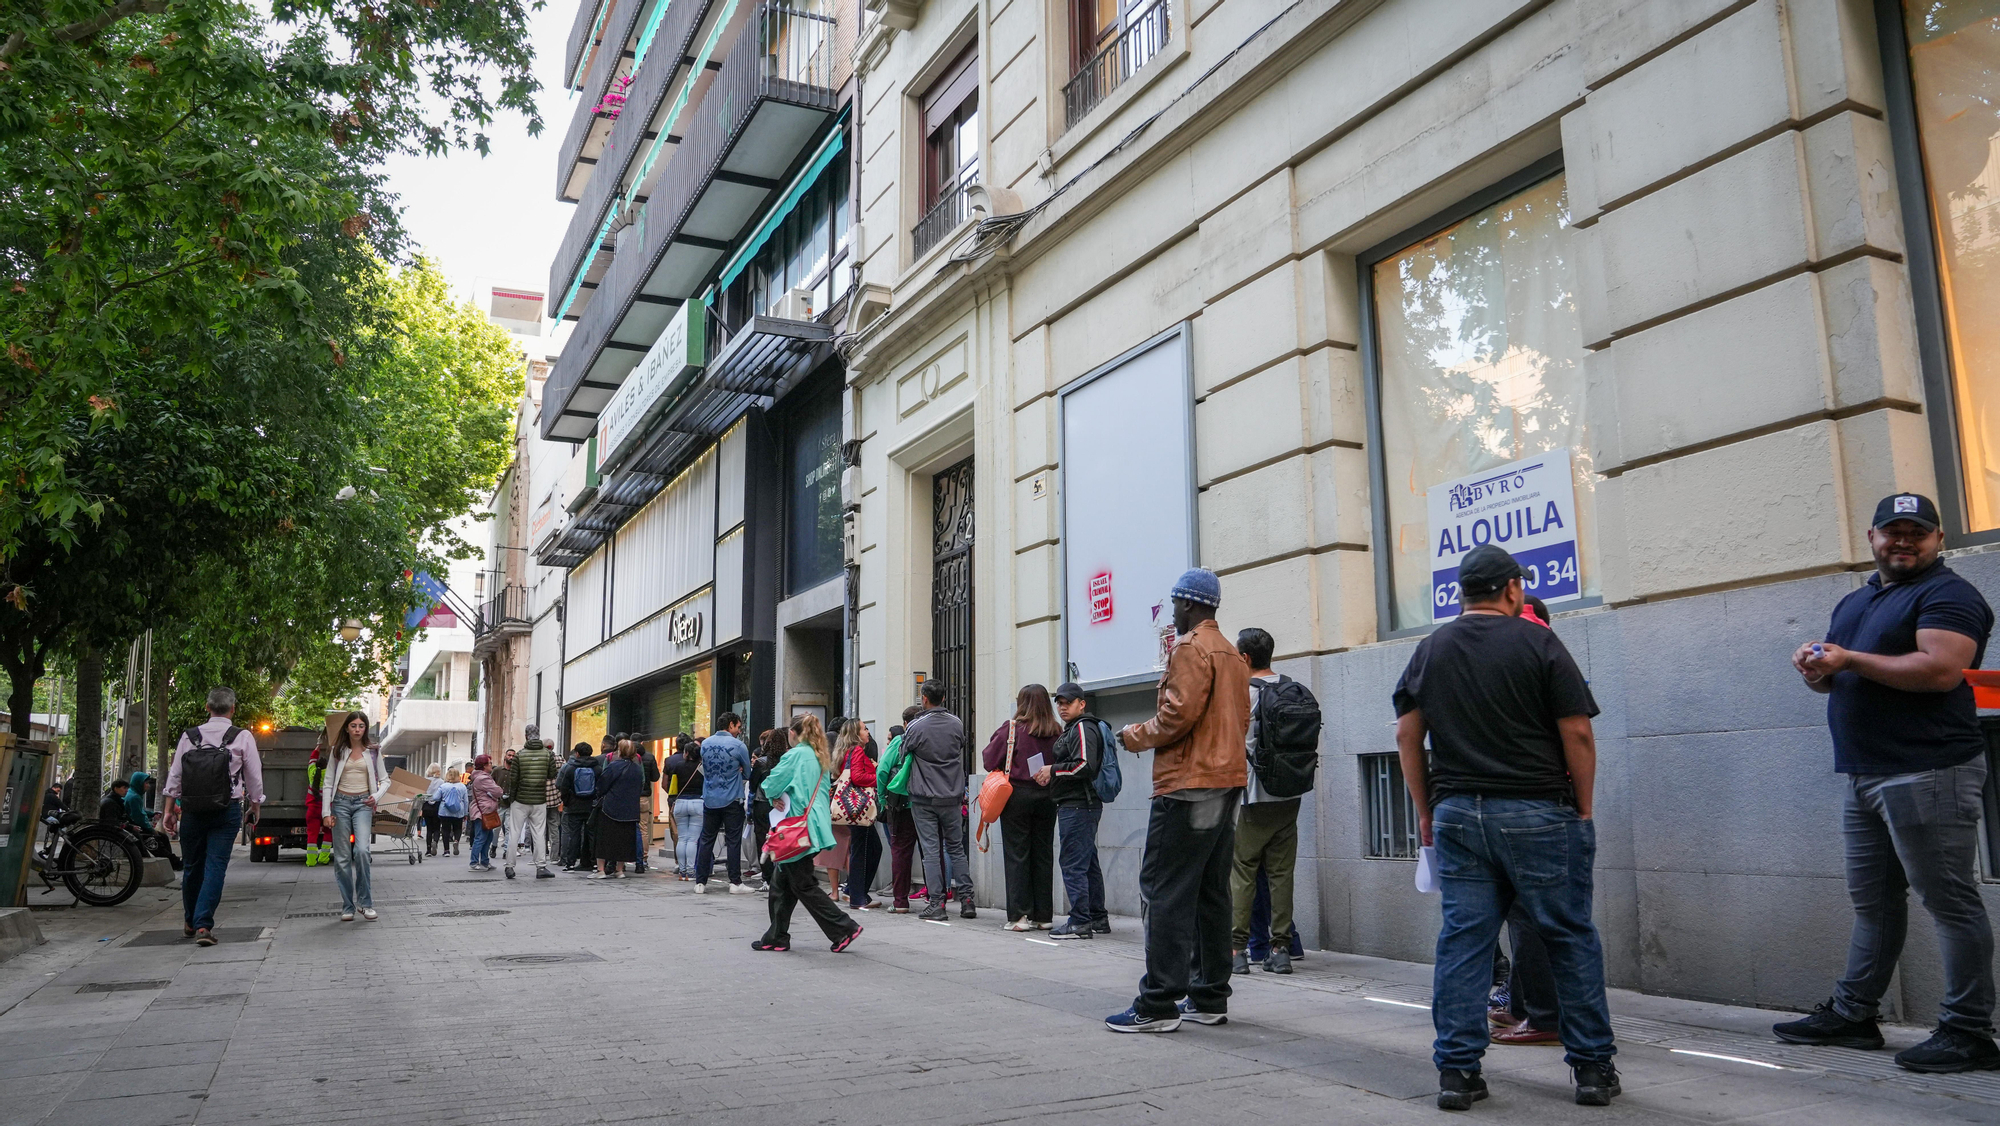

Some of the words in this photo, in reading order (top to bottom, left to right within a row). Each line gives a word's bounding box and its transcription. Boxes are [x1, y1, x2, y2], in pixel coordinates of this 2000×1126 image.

[608, 386, 635, 434] AVILÉS
[637, 375, 645, 396] &
[646, 322, 683, 385] IBÁÑEZ
[1455, 509, 1474, 519] AGENCIA
[1486, 499, 1511, 511] PROPIEDAD
[1511, 491, 1541, 504] INMOBILIARIA
[965, 512, 973, 540] 2
[1434, 581, 1460, 608] 62
[1546, 556, 1577, 587] 34
[1093, 597, 1109, 610] STOP
